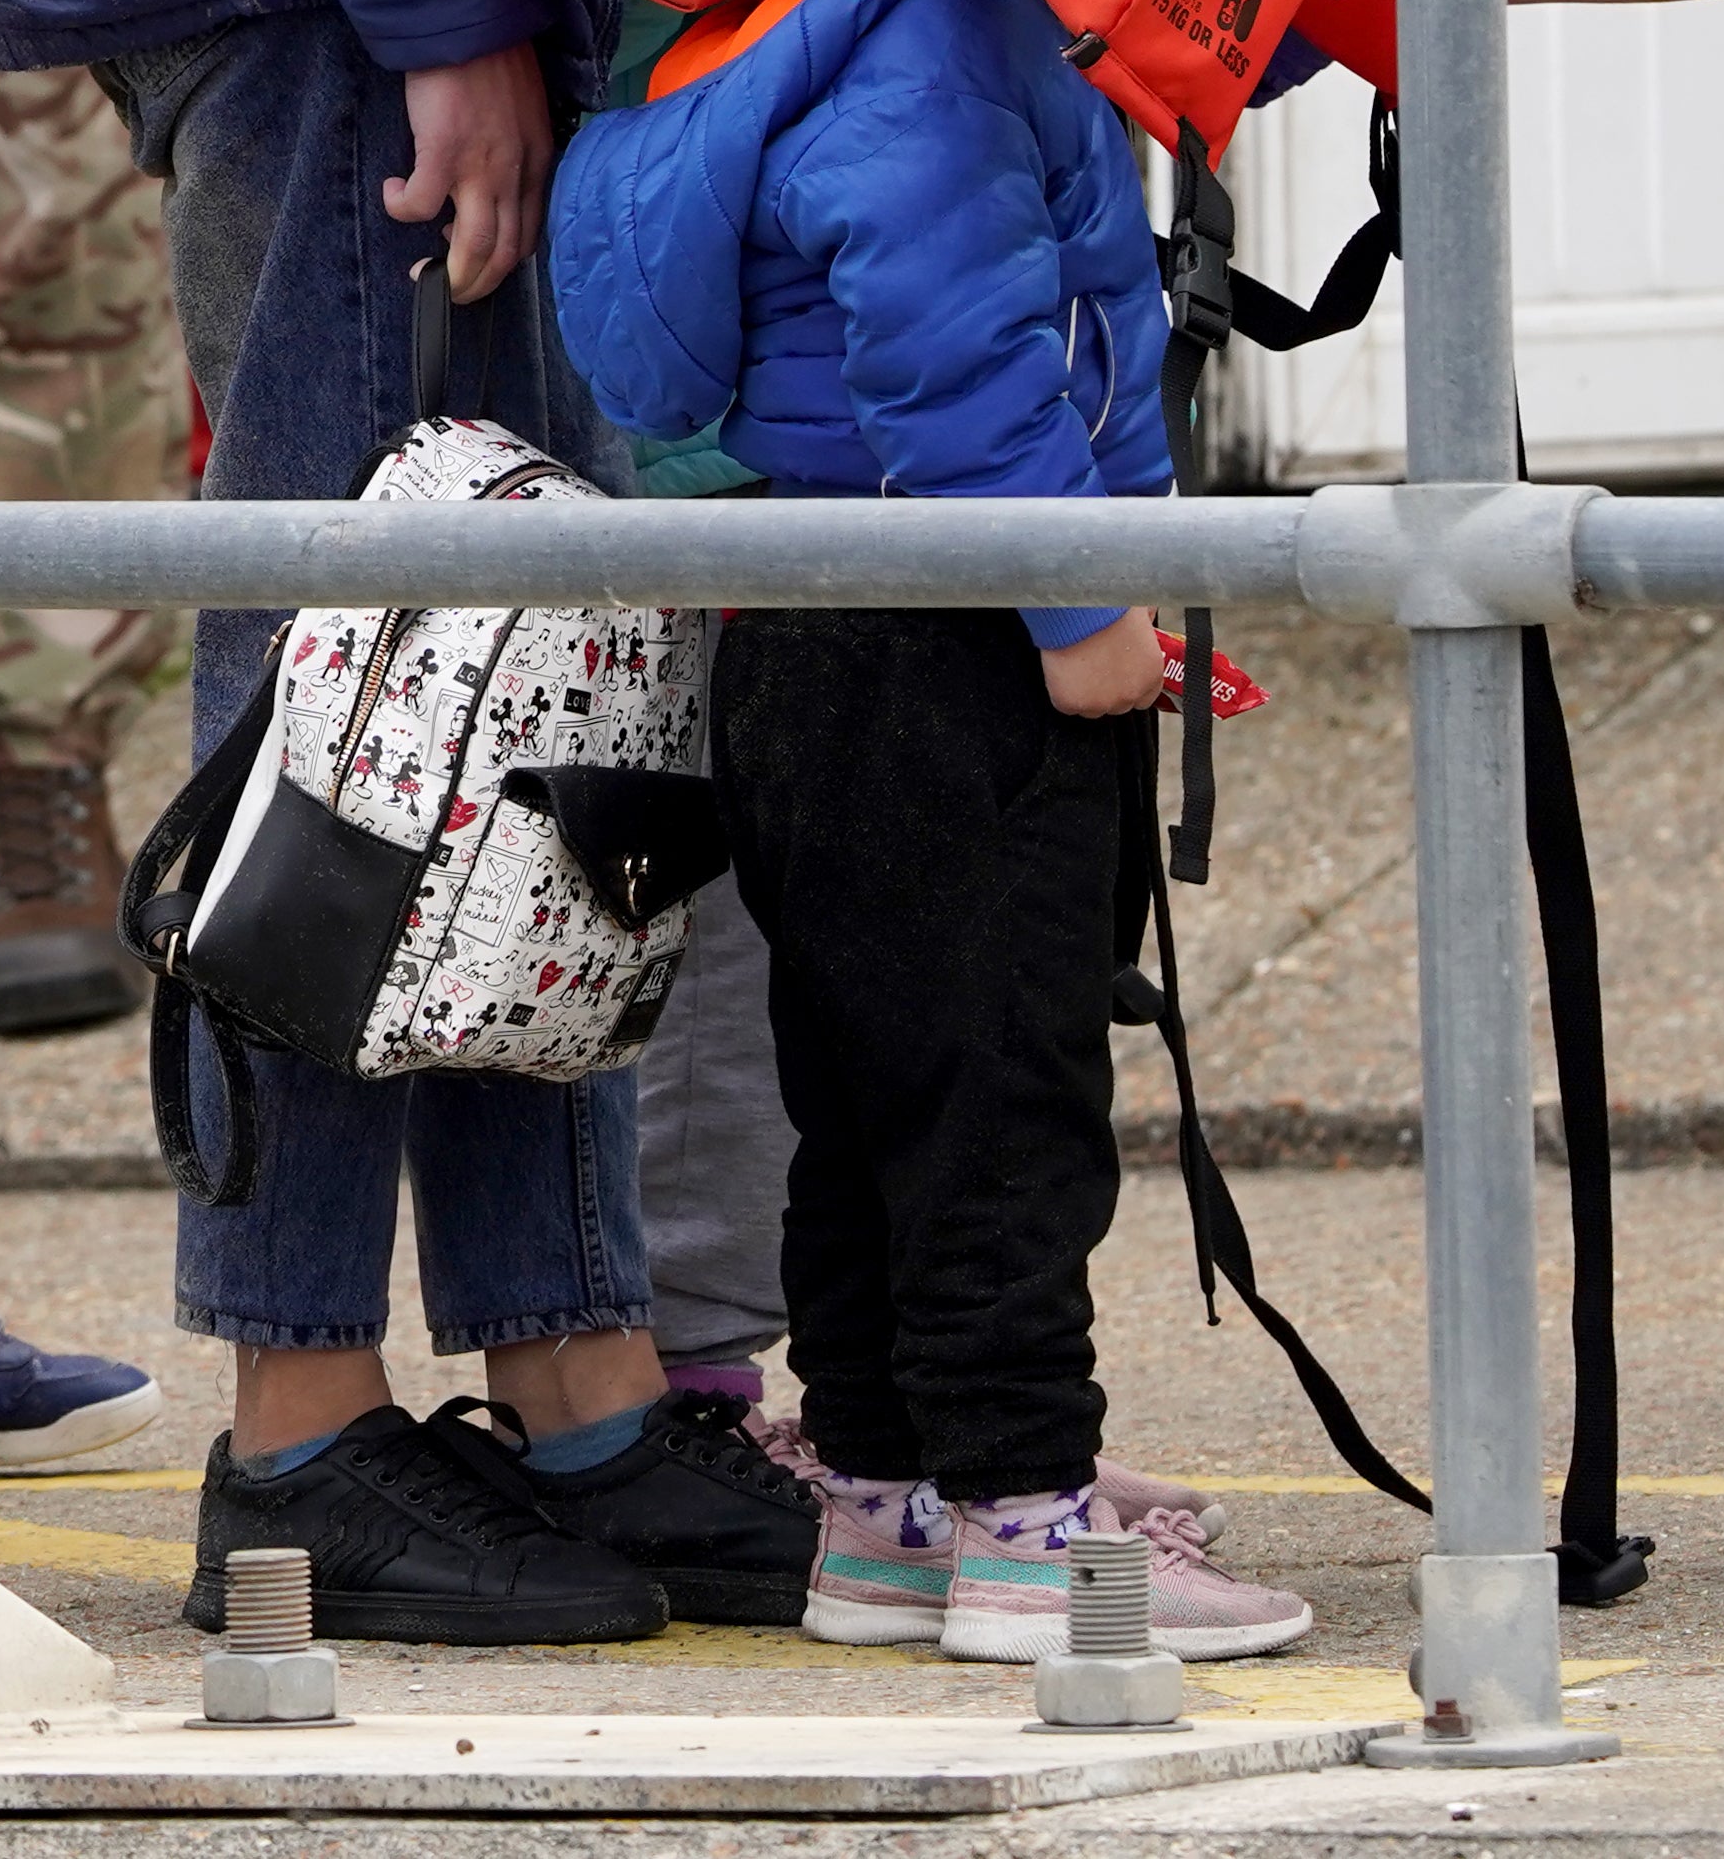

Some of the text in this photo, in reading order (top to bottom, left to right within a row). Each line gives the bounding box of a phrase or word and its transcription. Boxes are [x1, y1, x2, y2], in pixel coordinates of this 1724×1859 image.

[1188, 19, 1213, 50] OR
[1216, 37, 1250, 79] LESS
[566, 694, 591, 711] LOVE
[640, 973, 665, 992] ALL
